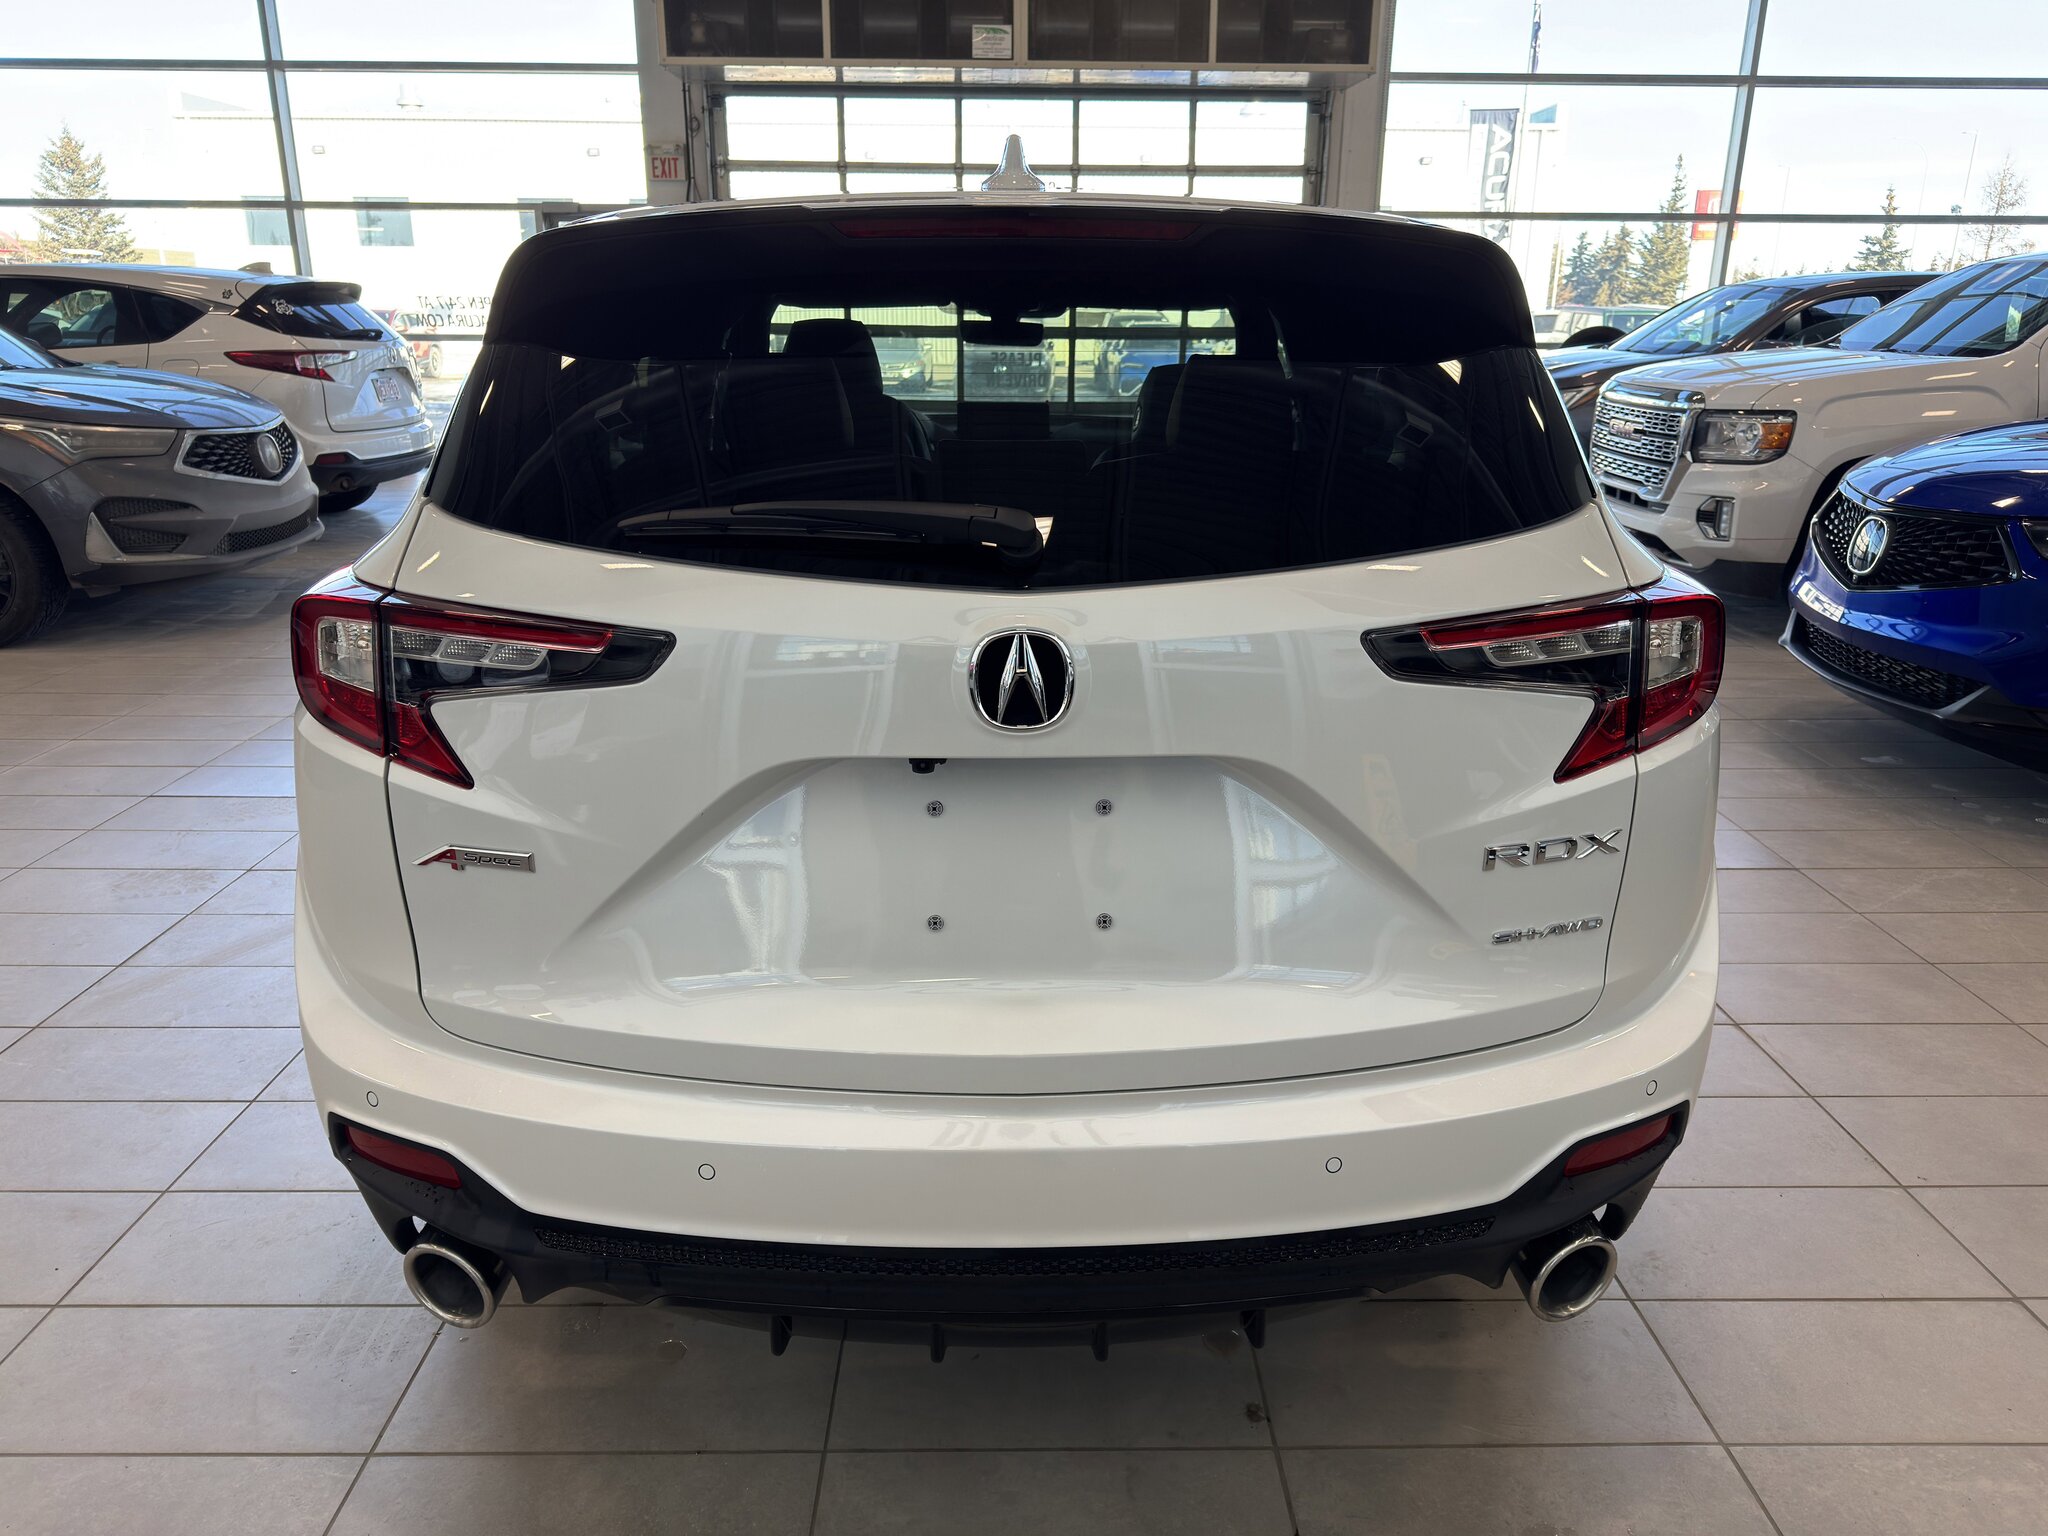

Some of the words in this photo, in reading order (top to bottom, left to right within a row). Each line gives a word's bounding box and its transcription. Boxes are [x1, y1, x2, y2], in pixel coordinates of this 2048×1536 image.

[651, 157, 679, 179] EXIT
[1610, 418, 1645, 439] GMC
[1482, 828, 1623, 872] RDX
[1491, 916, 1604, 945] SH-AWD
